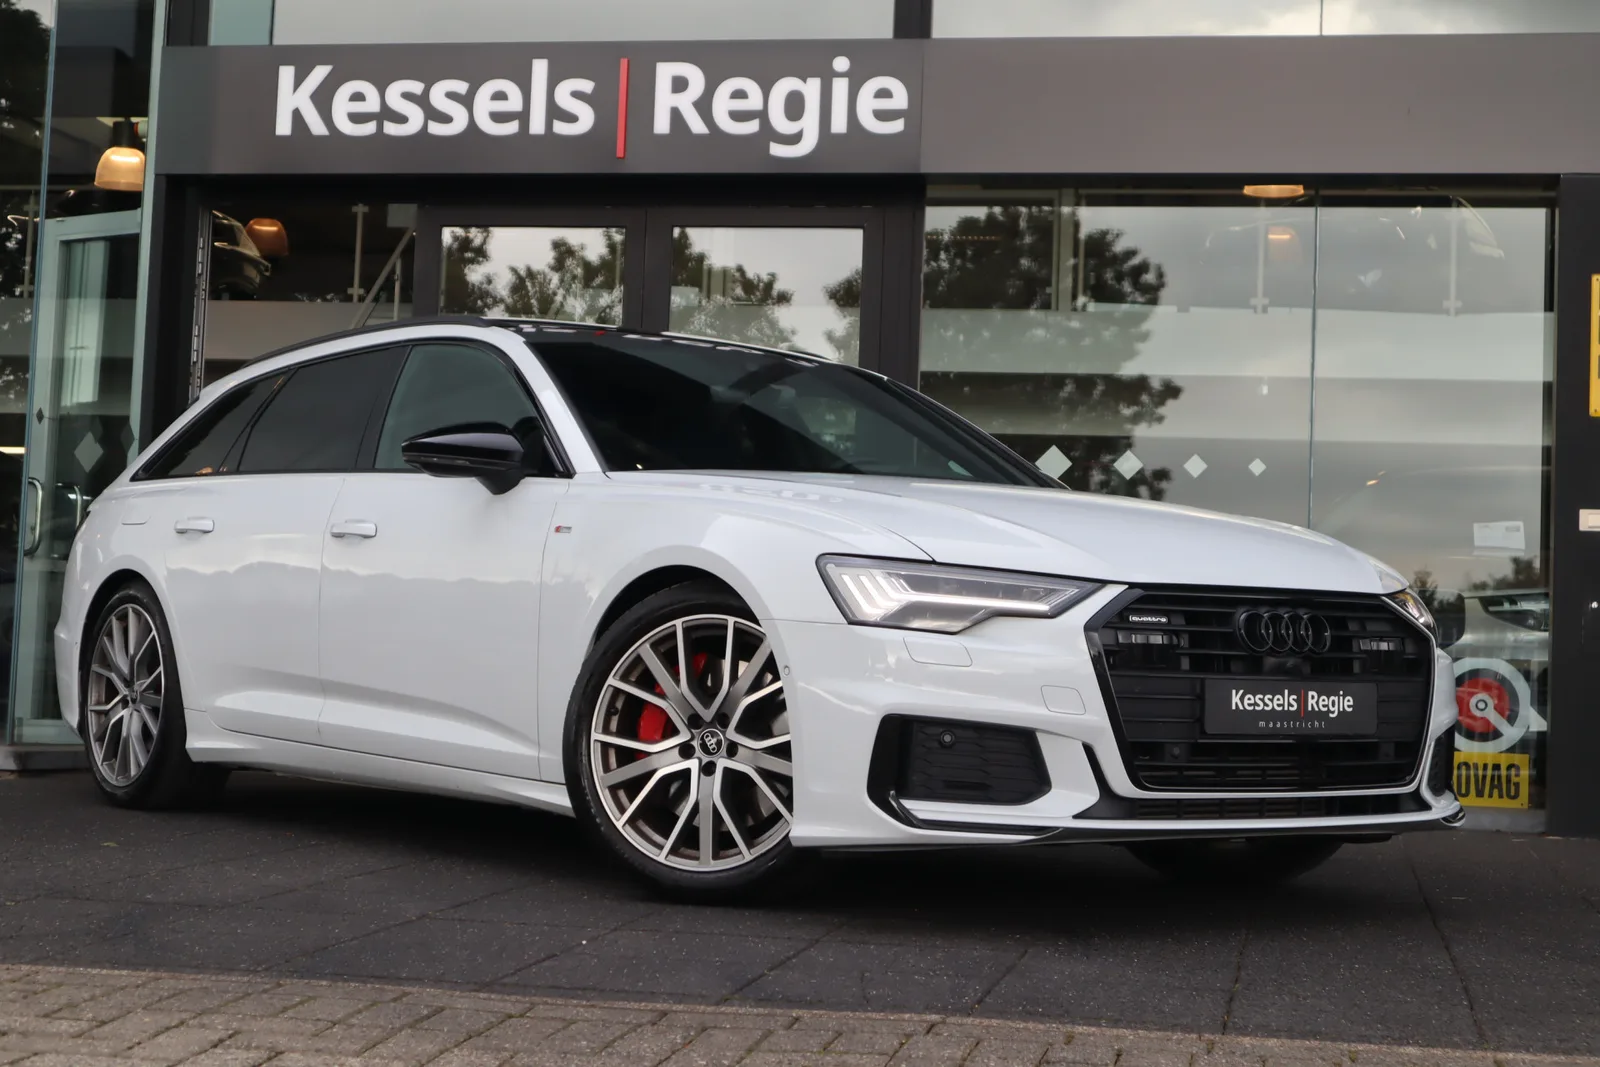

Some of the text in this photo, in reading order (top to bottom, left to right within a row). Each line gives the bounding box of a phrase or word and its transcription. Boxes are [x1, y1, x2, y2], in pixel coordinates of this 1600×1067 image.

[275, 55, 909, 158] Kessels Regie
[1231, 689, 1354, 718] Kessels Regie
[1259, 720, 1326, 729] maastricht
[1456, 761, 1521, 800] OVAG
